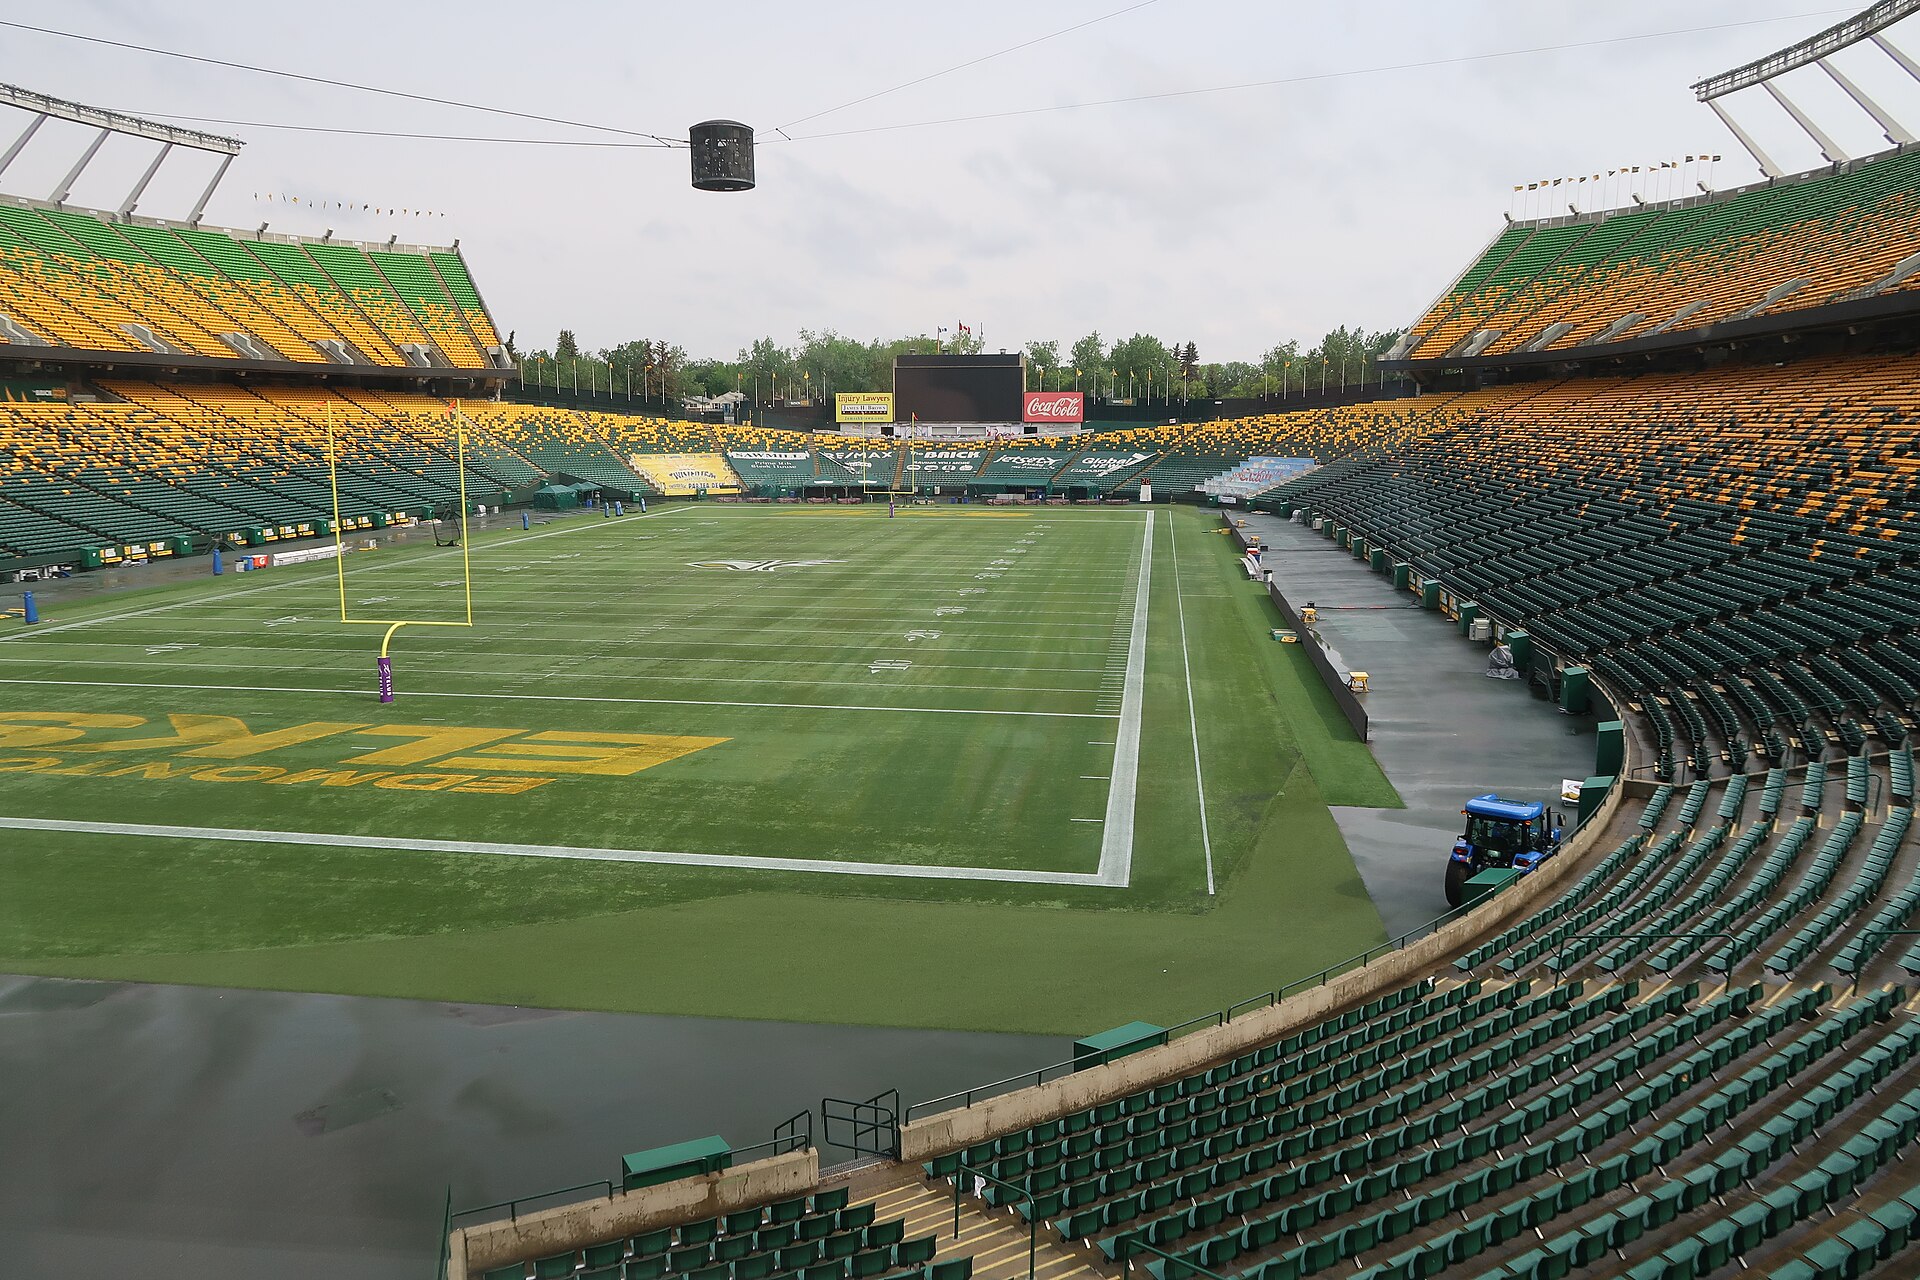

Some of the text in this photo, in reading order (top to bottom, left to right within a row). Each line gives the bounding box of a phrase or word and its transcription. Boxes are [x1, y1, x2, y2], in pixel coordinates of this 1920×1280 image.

[838, 395, 890, 404] Injury Lawyers
[1027, 397, 1081, 416] Coca-Cola
[823, 451, 893, 459] RE/MAX
[924, 451, 979, 459] BRICK
[1082, 457, 1133, 465] Global
[0, 757, 558, 795] EDMONTO
